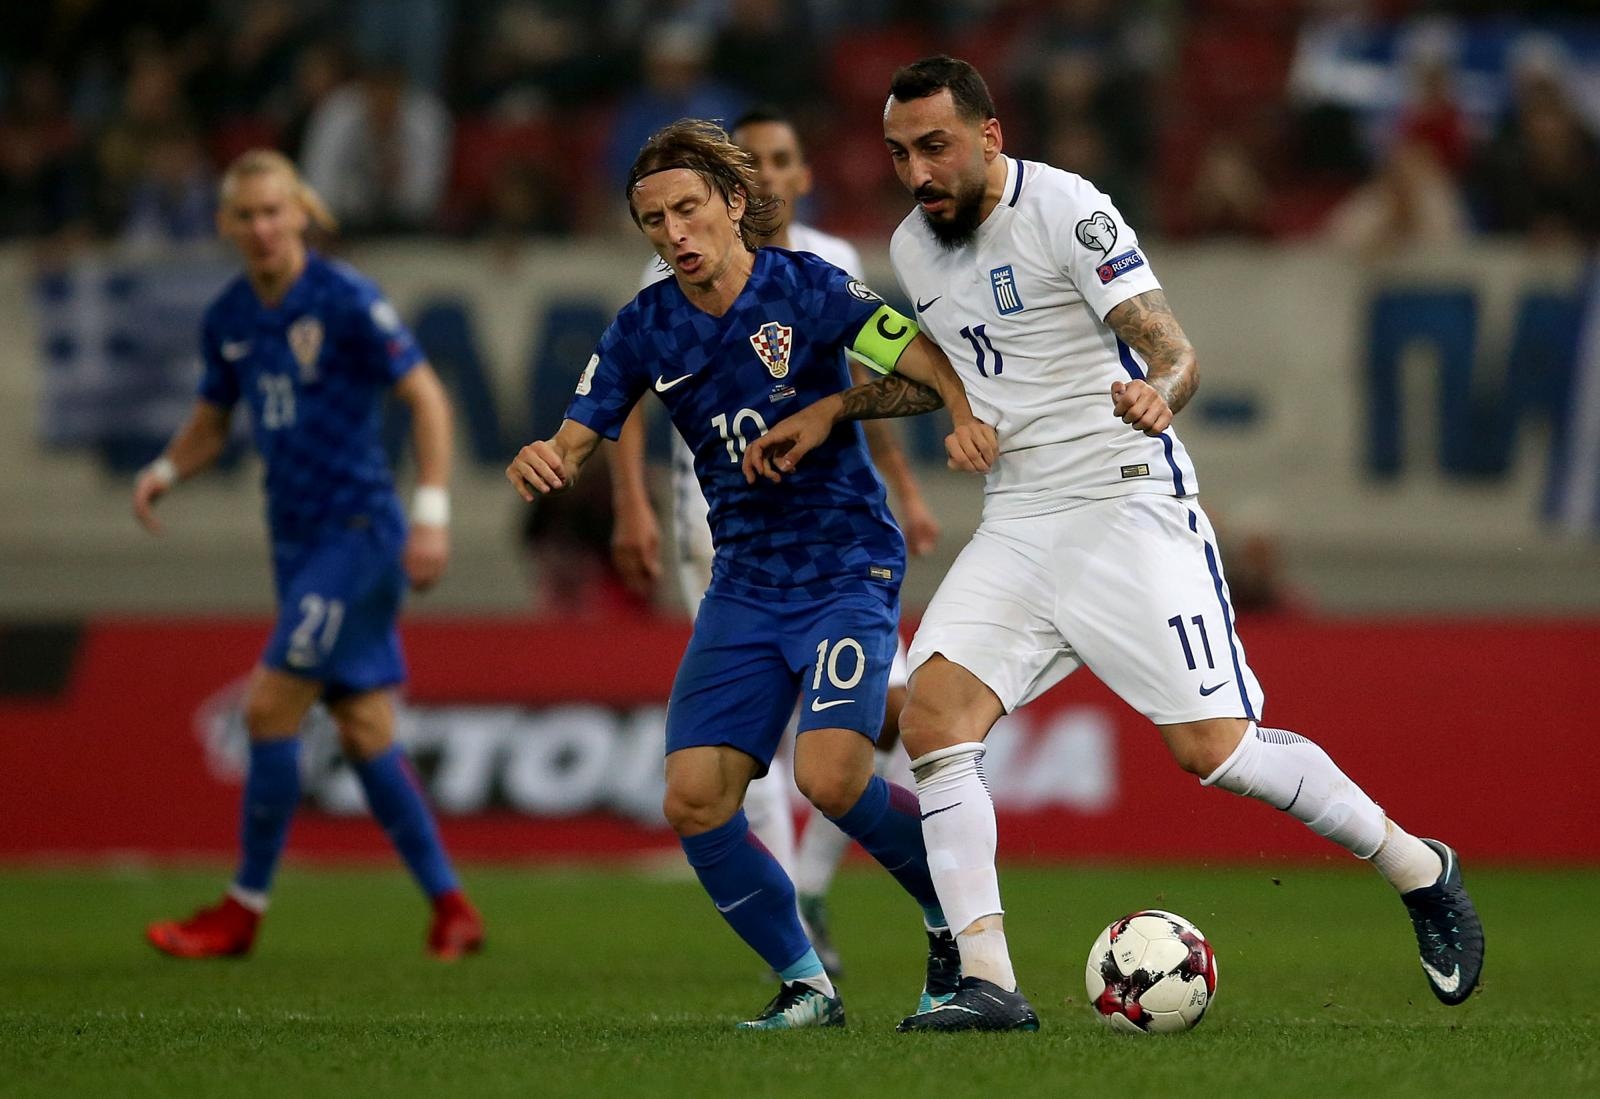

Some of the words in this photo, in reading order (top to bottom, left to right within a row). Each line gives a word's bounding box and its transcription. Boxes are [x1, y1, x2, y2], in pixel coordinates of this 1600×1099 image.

[876, 313, 908, 340] C
[959, 323, 1004, 378] 11
[258, 371, 297, 430] 21
[711, 408, 769, 464] 10
[290, 593, 345, 658] 21
[1167, 614, 1215, 671] 11
[812, 637, 866, 690] 10
